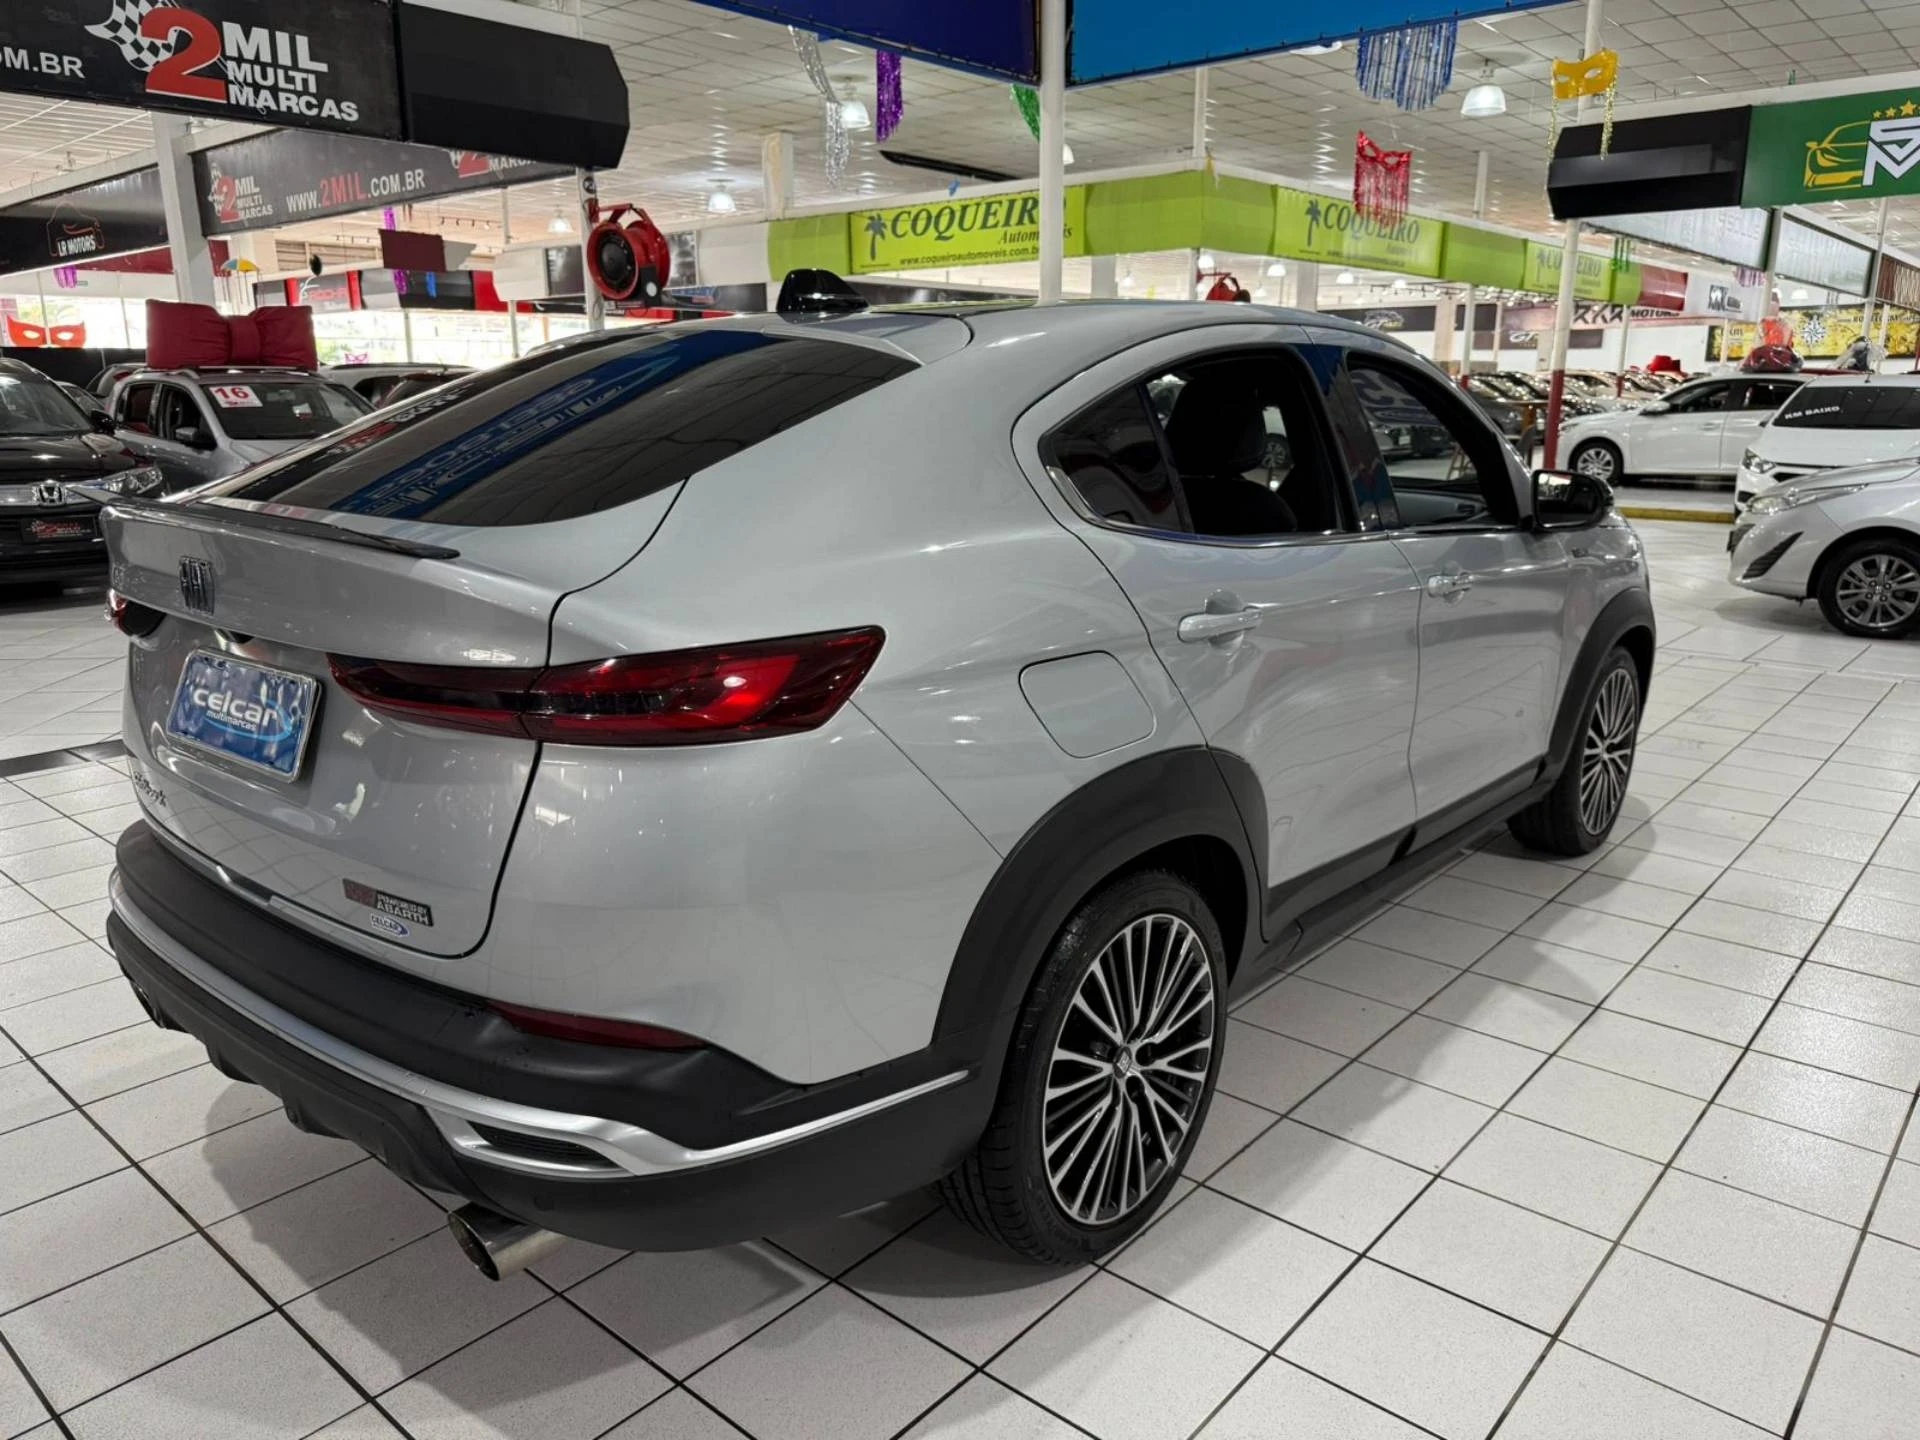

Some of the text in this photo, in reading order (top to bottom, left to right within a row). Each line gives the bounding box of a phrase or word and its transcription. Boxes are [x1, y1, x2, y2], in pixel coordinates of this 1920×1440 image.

[141, 7, 328, 103] 2 MIL
[227, 60, 318, 93] MULTI
[228, 83, 360, 122] MARCAS
[234, 175, 260, 195] MIL
[286, 168, 426, 213] WWW.2MIL.COM.BR
[238, 204, 274, 219] MARCAS
[890, 196, 1067, 241] COQUEIR
[998, 223, 1073, 245] Automis
[899, 246, 1041, 265] www.coqueiroautomoveis.com.b
[1804, 405, 1841, 416] BAIXO
[193, 687, 278, 726] celcar
